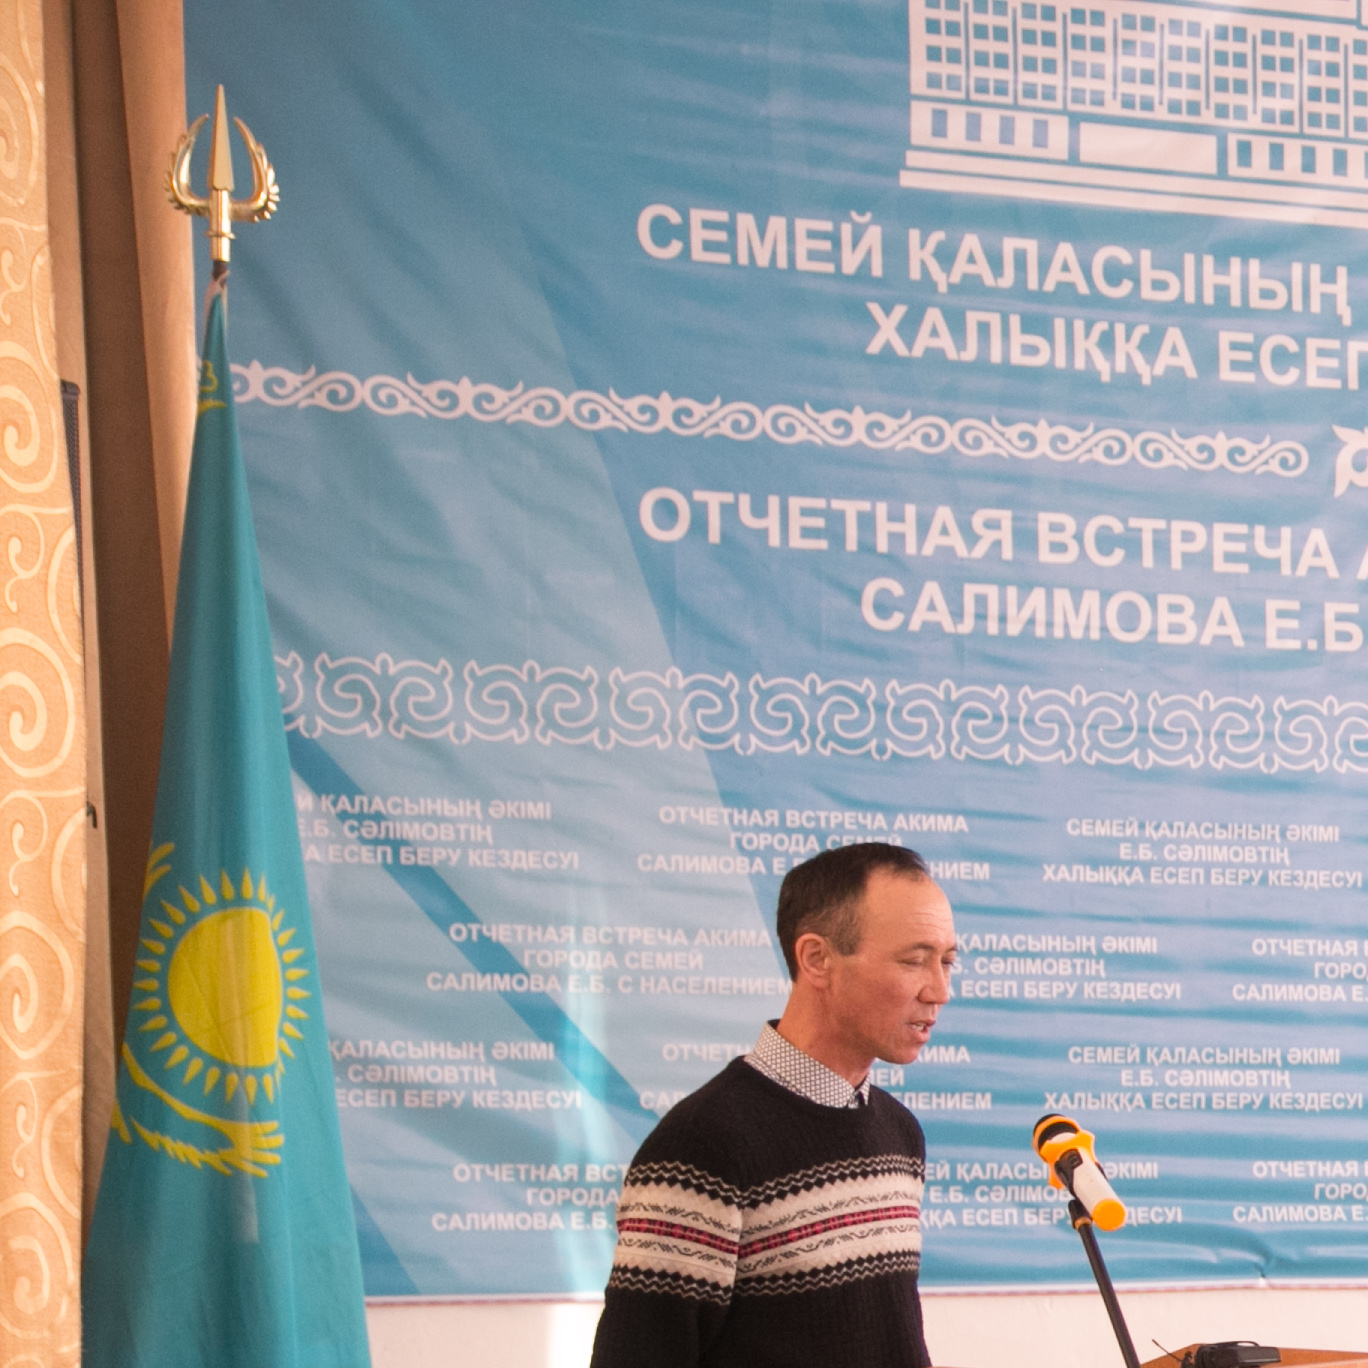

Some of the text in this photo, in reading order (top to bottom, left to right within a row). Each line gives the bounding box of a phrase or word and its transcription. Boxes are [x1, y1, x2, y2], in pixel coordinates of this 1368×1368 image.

[637, 205, 882, 275] СЕМЕЙ
[908, 231, 1350, 321] ҚАЛАСЫНЫҢ
[866, 304, 1197, 382] ХАЛЫҚҚА
[639, 488, 1013, 559] ОТЧЕТНАЯ
[1038, 513, 1338, 576] ВСТРЕЧА
[861, 579, 1245, 645] САЛИМОВА
[1067, 816, 1339, 844] СЕМЕЙ ҚАЛАСЫНЫҢ ӘКІМІ
[1120, 842, 1291, 868] Е.Б. СӘЛІМОВТІҢ
[1043, 864, 1363, 892] ХАЛЫҚҚА ЕСЕП БЕРУ КЕЗДЕСУІ
[450, 924, 771, 947] ОТЧЕТНАЯ ВСТРЕЧА АКИМА
[1252, 938, 1357, 957] ОТЧЕТНАЯ
[524, 948, 702, 972] ГОРОДА СЕМЕЙ
[427, 972, 561, 992] САЛИМОВА
[567, 974, 610, 993] Е.Б.
[616, 975, 632, 993] С
[1233, 984, 1347, 1002] САЛИМОВА
[1068, 1041, 1341, 1067] СЕМЕЙ ҚАЛАСЫНЫҢ ӘКІМІ
[1121, 1069, 1291, 1091] Е.Б. СӘЛІМОВТІҢ
[1044, 1091, 1364, 1114] ХАЛЫҚҚА ЕСЕП БЕРУ КЕЗДЕСУІ
[1253, 1160, 1357, 1179] ОТЧЕТНАЯ
[1233, 1204, 1347, 1223] САЛИМОВА
